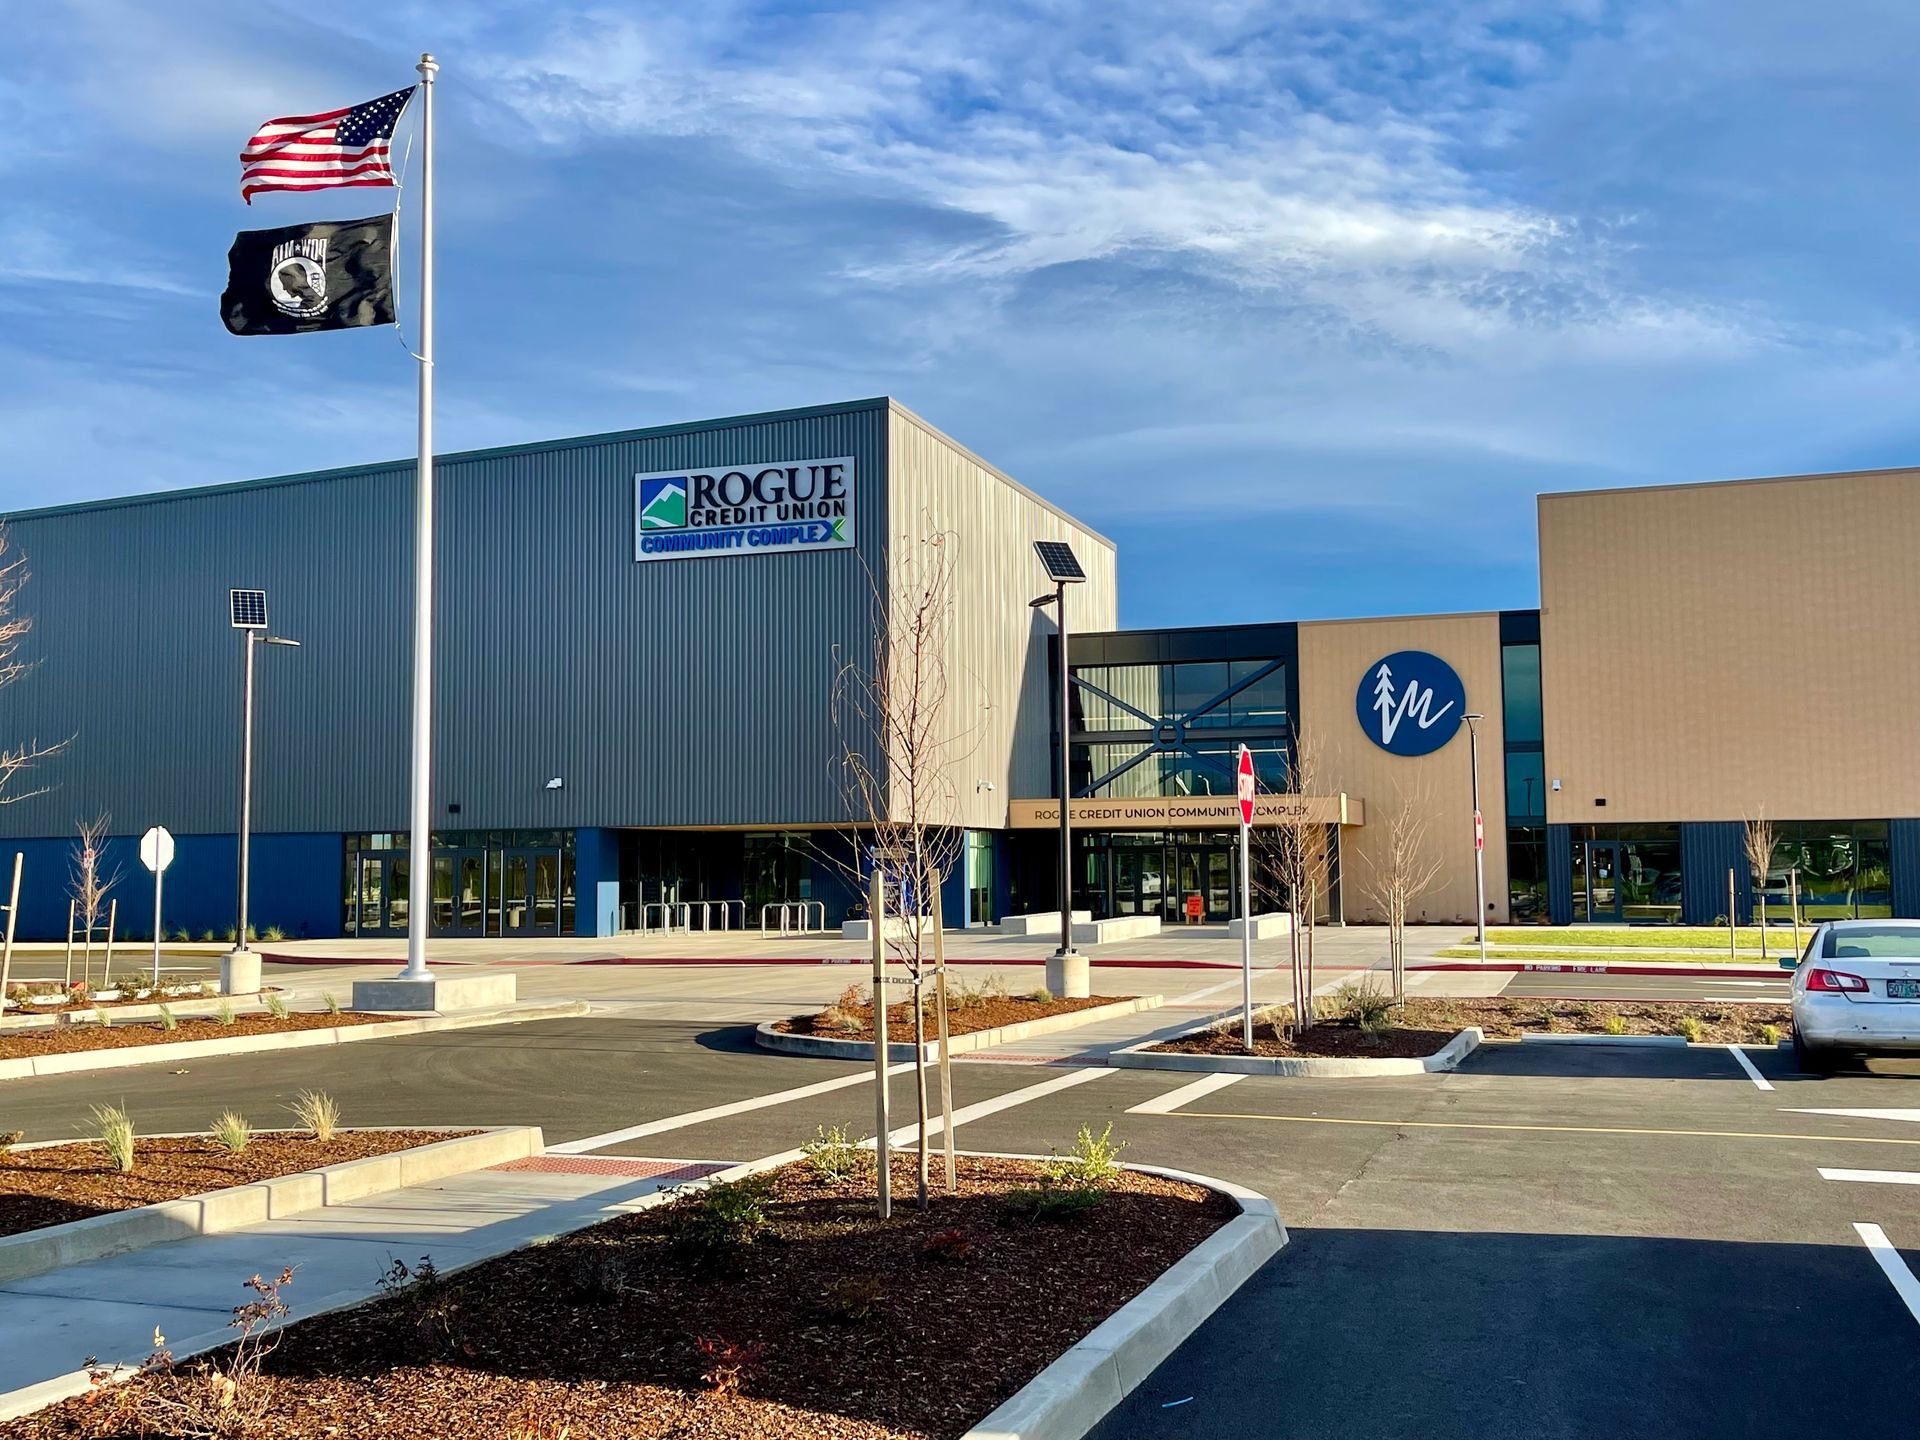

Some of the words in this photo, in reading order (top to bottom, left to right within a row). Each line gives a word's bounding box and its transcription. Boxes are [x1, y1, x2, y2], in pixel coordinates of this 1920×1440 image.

[690, 464, 847, 509] ROGUE
[690, 505, 768, 527] CREDIT
[776, 500, 846, 521] UNION
[640, 530, 744, 553] COMMUNITY
[747, 518, 847, 546] COMPLEX
[1035, 810, 1076, 820] ROGE
[1079, 809, 1122, 819] CREDIT
[1125, 808, 1165, 818] UNION
[1254, 805, 1308, 816] OMPLEX
